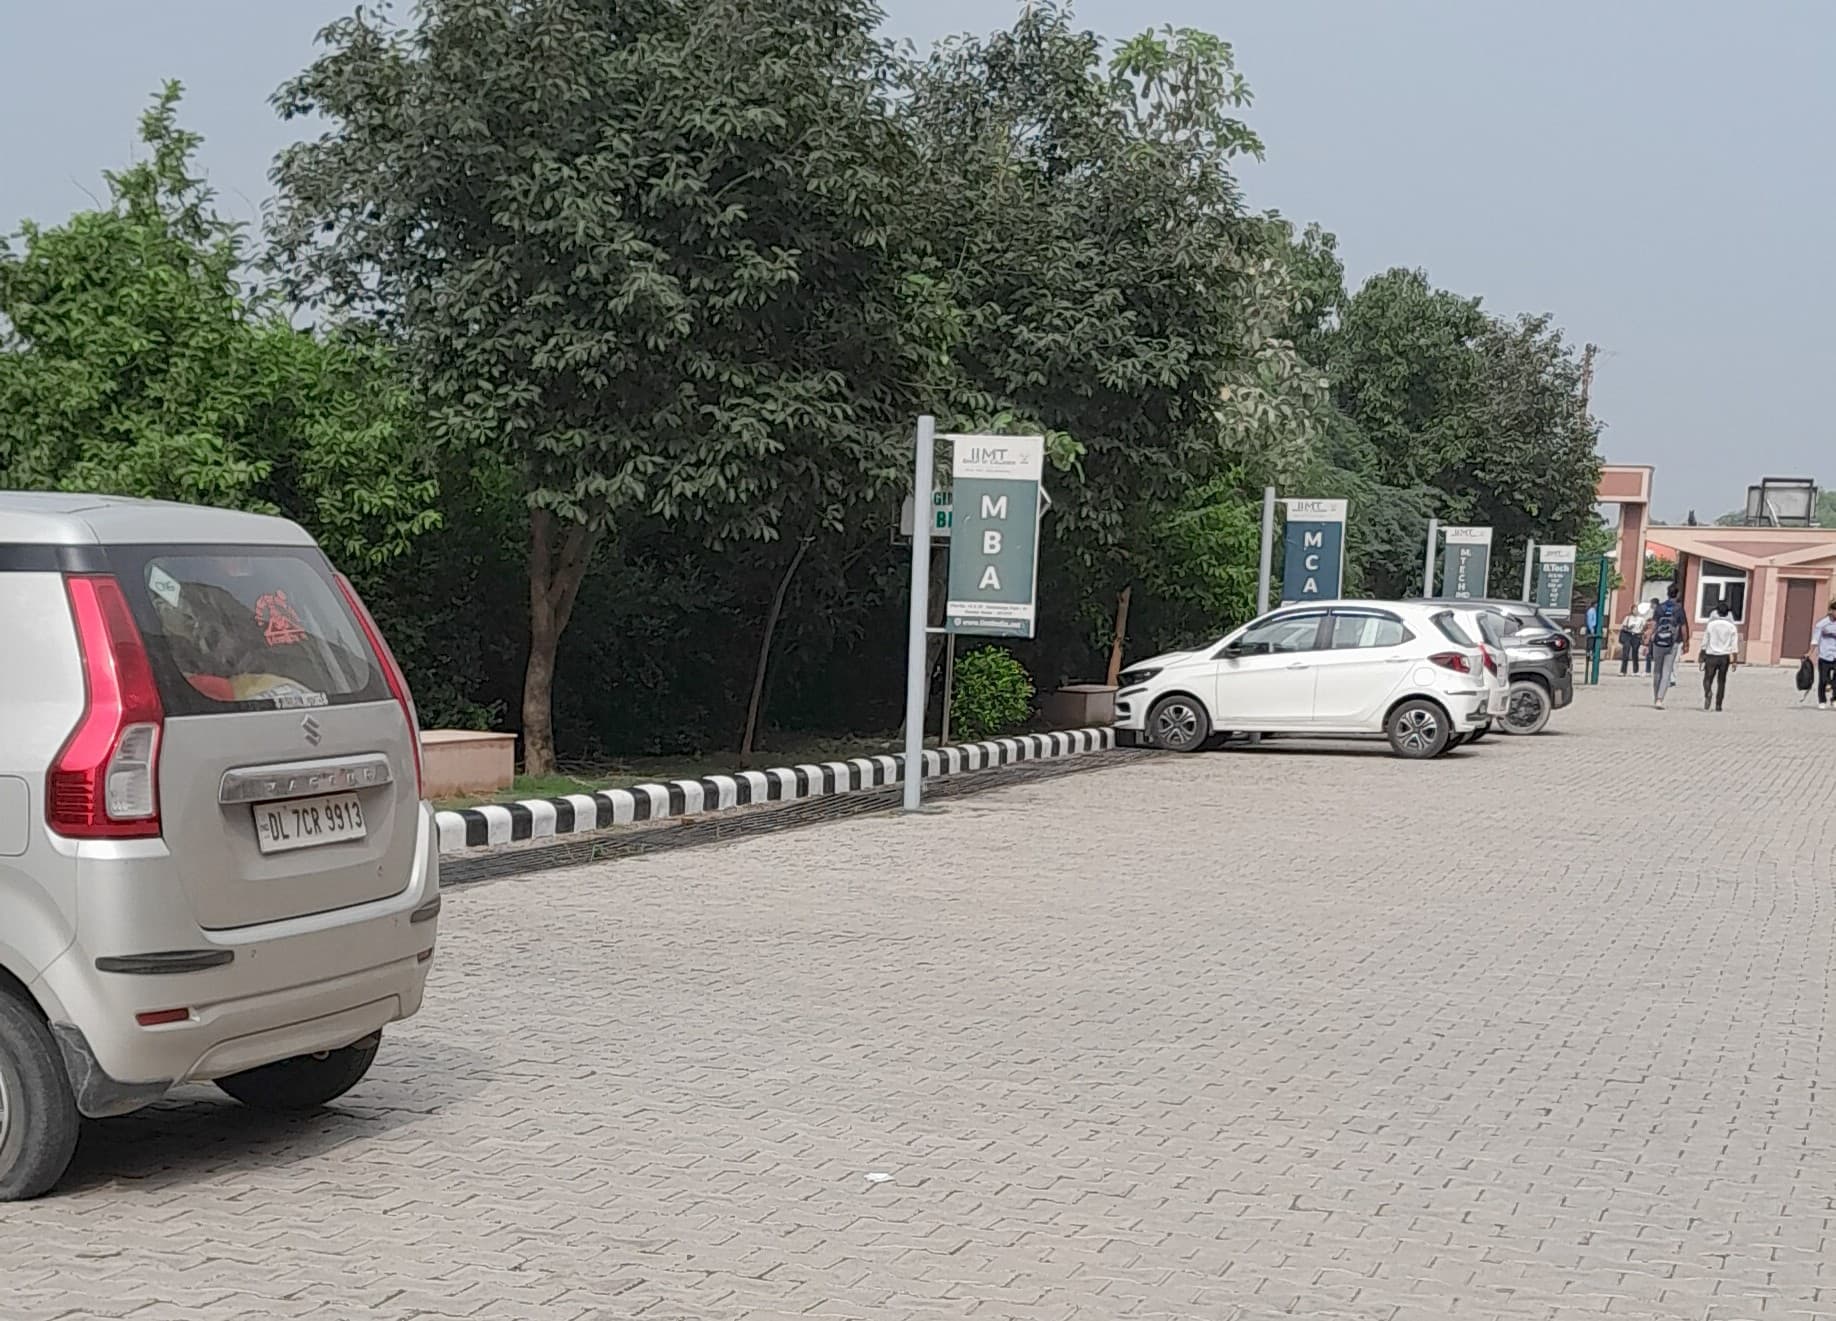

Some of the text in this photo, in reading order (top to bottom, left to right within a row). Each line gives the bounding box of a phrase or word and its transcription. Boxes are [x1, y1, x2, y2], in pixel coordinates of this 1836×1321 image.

[979, 495, 1008, 590] MBA
[1303, 531, 1322, 593] MCA
[268, 801, 362, 841] DL 7CR 9913
